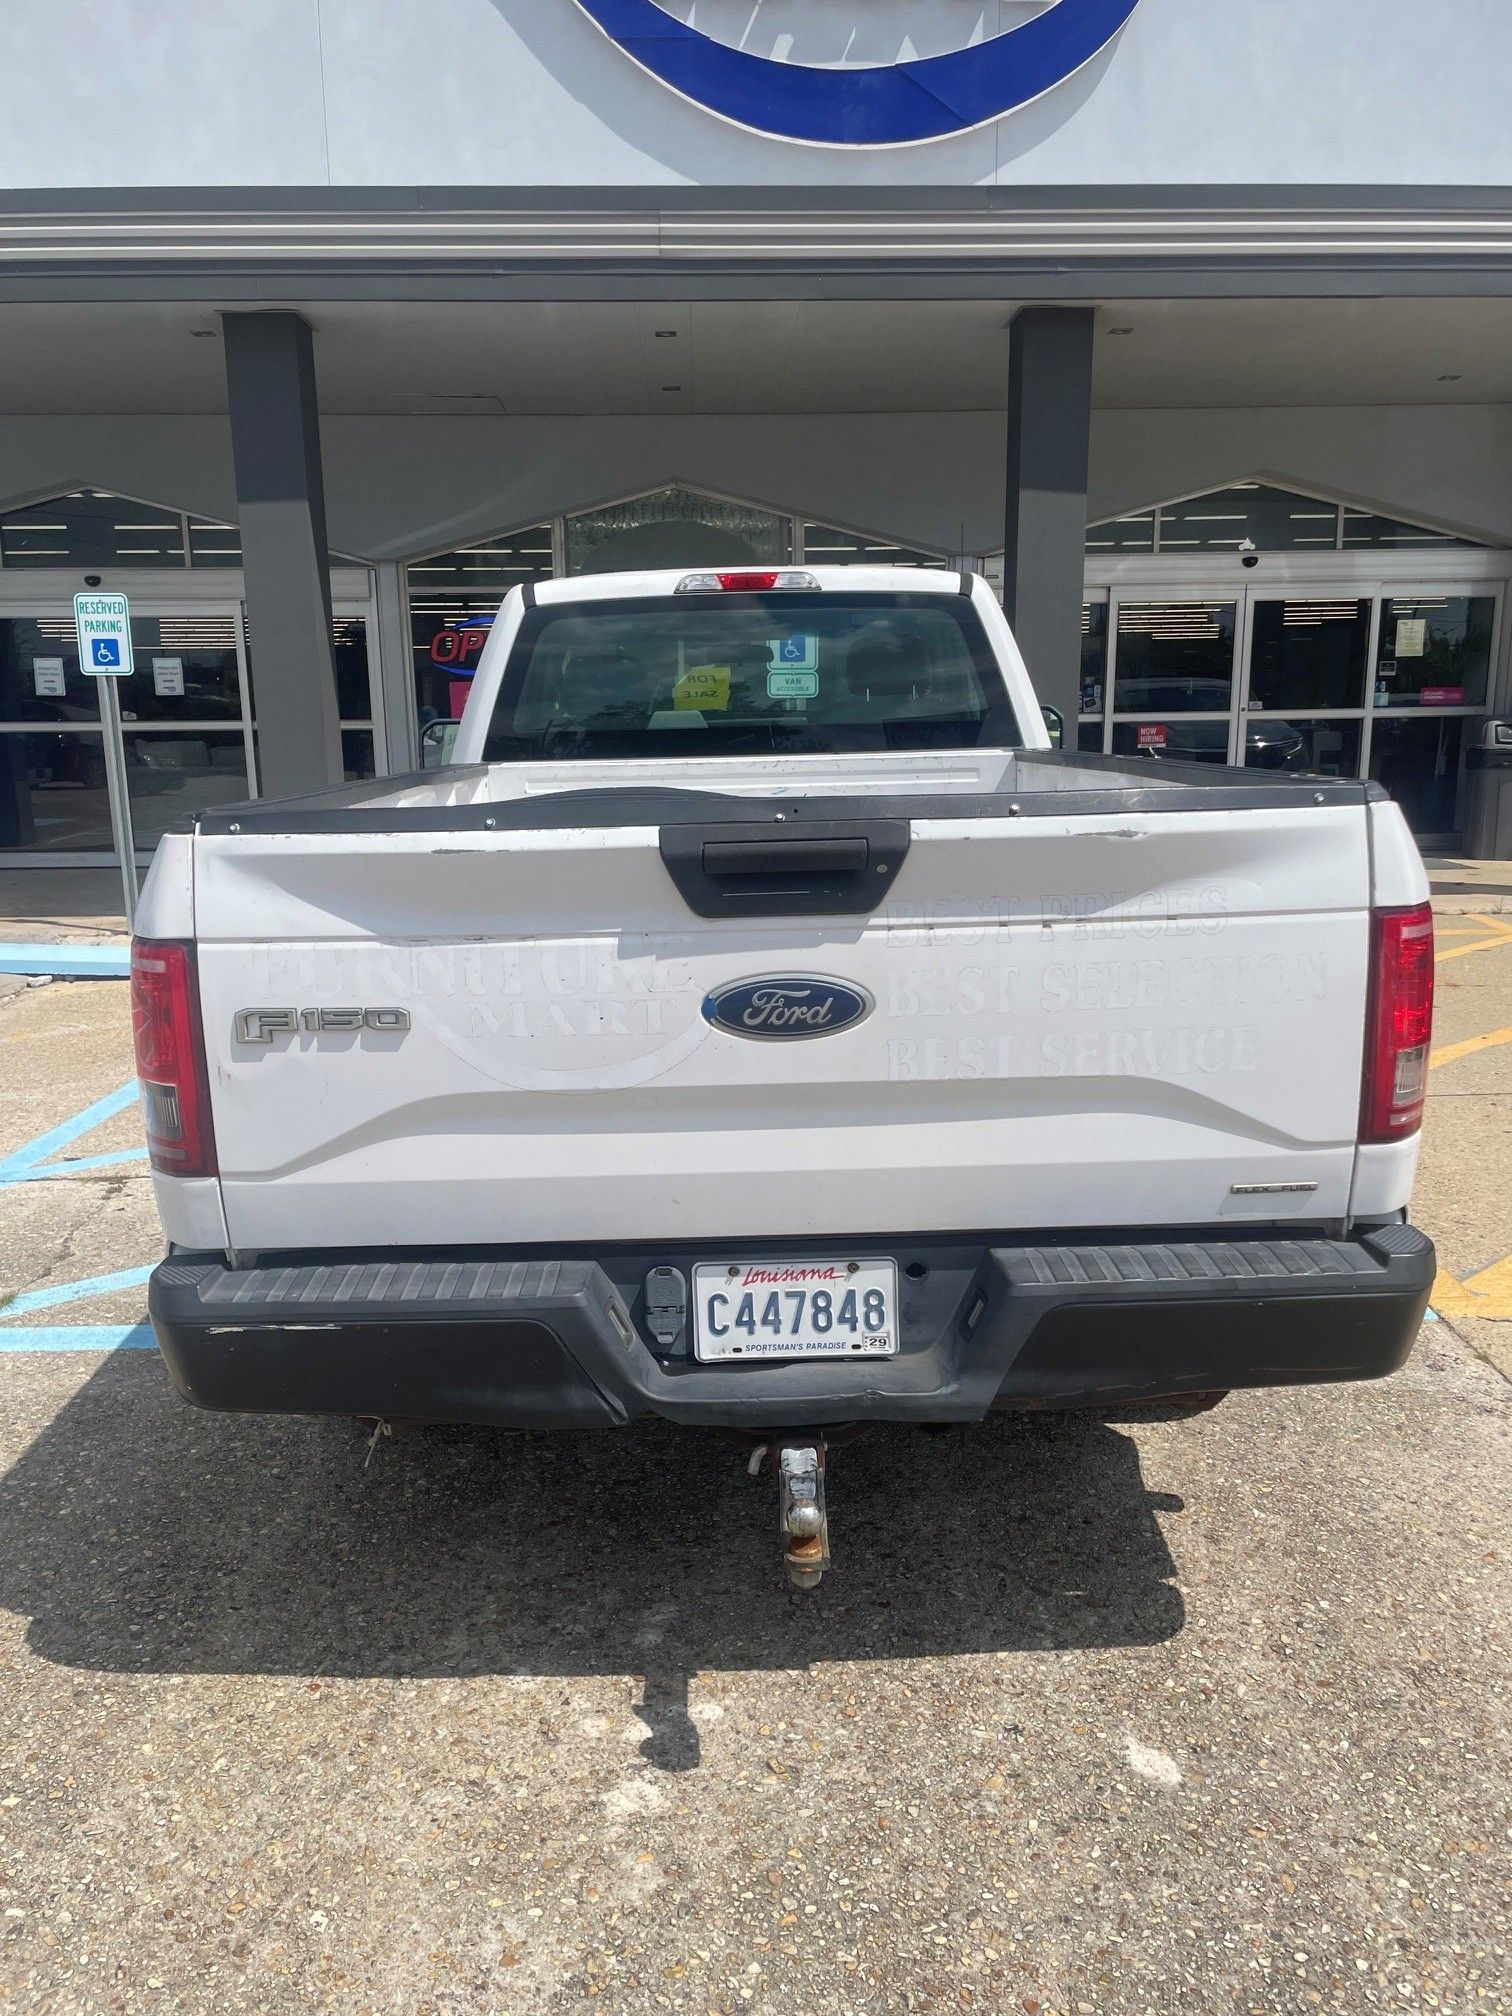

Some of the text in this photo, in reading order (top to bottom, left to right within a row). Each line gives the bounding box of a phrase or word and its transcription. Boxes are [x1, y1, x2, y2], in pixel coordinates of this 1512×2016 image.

[79, 602, 124, 614] RESERVED
[84, 620, 122, 632] PARKING
[430, 630, 485, 662] OP
[785, 677, 801, 686] VAN
[1140, 727, 1157, 735] NOW
[1140, 735, 1164, 743] HIRING
[886, 965, 1022, 1018] BEST
[742, 988, 833, 1026] Ford
[466, 999, 678, 1037] MART
[742, 1264, 846, 1287] Louisiana
[707, 1288, 886, 1336] C447848
[745, 1341, 847, 1352] SPORTSMAN'S PARADISE
[869, 1338, 887, 1347] 29
